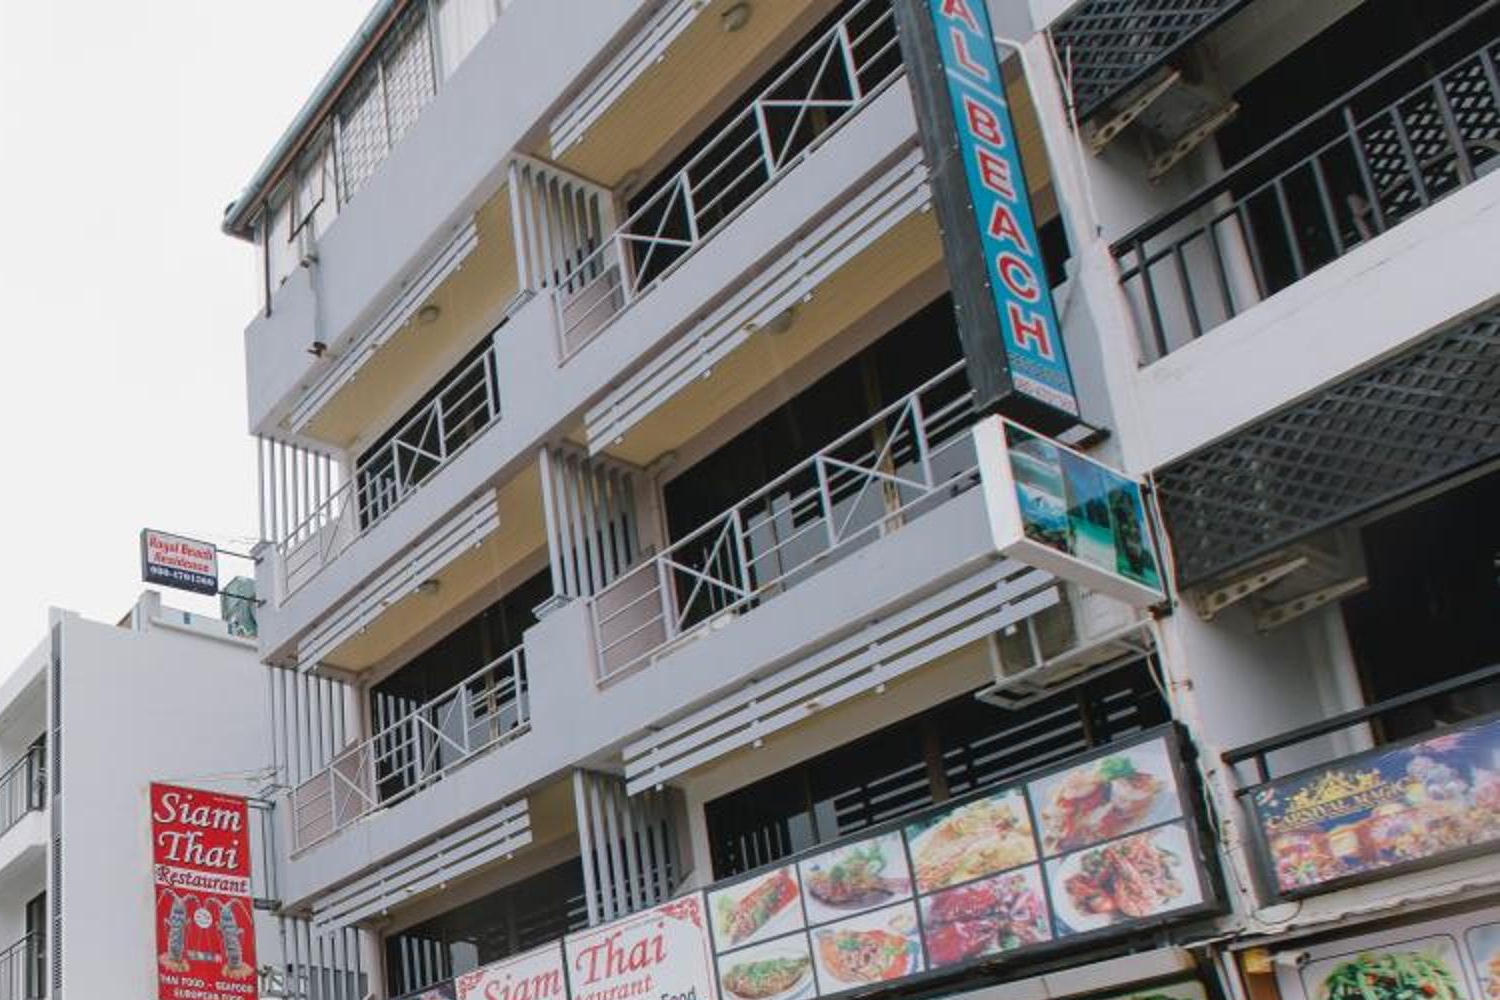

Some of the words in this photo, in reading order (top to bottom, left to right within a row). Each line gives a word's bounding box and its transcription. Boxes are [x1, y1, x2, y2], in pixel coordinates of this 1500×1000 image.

[964, 95, 1054, 362] BEACH
[154, 793, 241, 832] Siam
[159, 830, 239, 869] Thai
[156, 865, 248, 893] Restaurant
[576, 921, 666, 986] Thai
